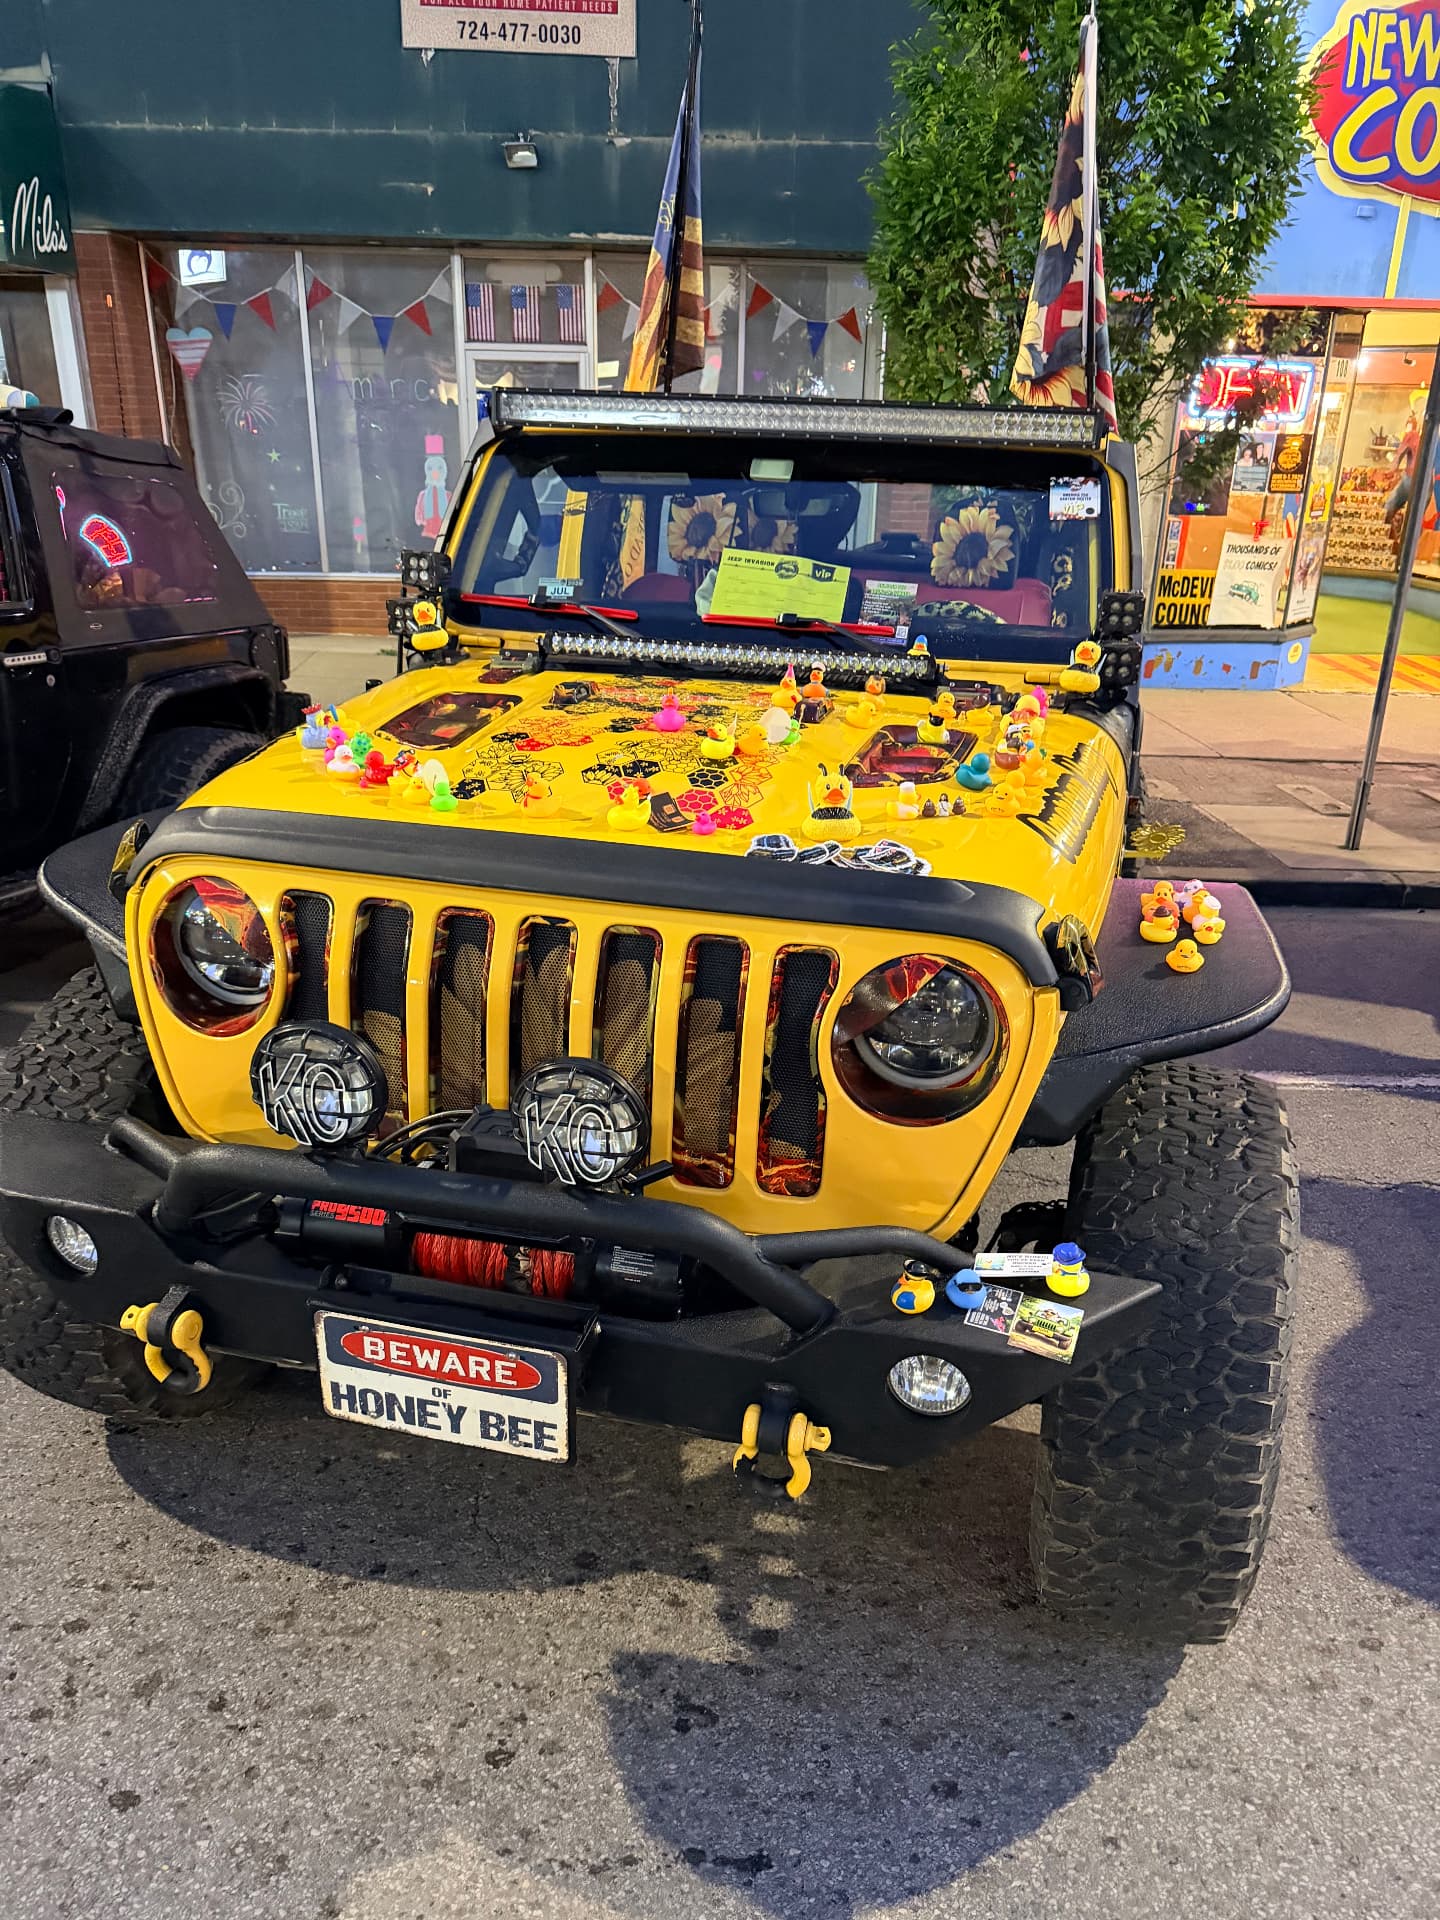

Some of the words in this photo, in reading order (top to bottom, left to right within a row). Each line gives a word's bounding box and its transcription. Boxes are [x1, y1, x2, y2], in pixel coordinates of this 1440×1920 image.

[535, 0, 576, 11] PATIENT
[582, 1, 613, 13] NEEDS
[456, 20, 582, 45] 724-477-0030
[11, 175, 68, 260] Milo's
[1226, 543, 1270, 556] THOUSANDS
[815, 568, 832, 579] VIP
[1245, 560, 1278, 571] COMICS!
[550, 587, 569, 595] JUL
[1158, 575, 1216, 599] McDEVI
[258, 1052, 349, 1147] KC
[524, 1093, 615, 1185] KC
[362, 1335, 518, 1386] BEWARE
[431, 1387, 452, 1400] OF
[330, 1381, 469, 1434] HONEY
[479, 1410, 559, 1454] BEE
